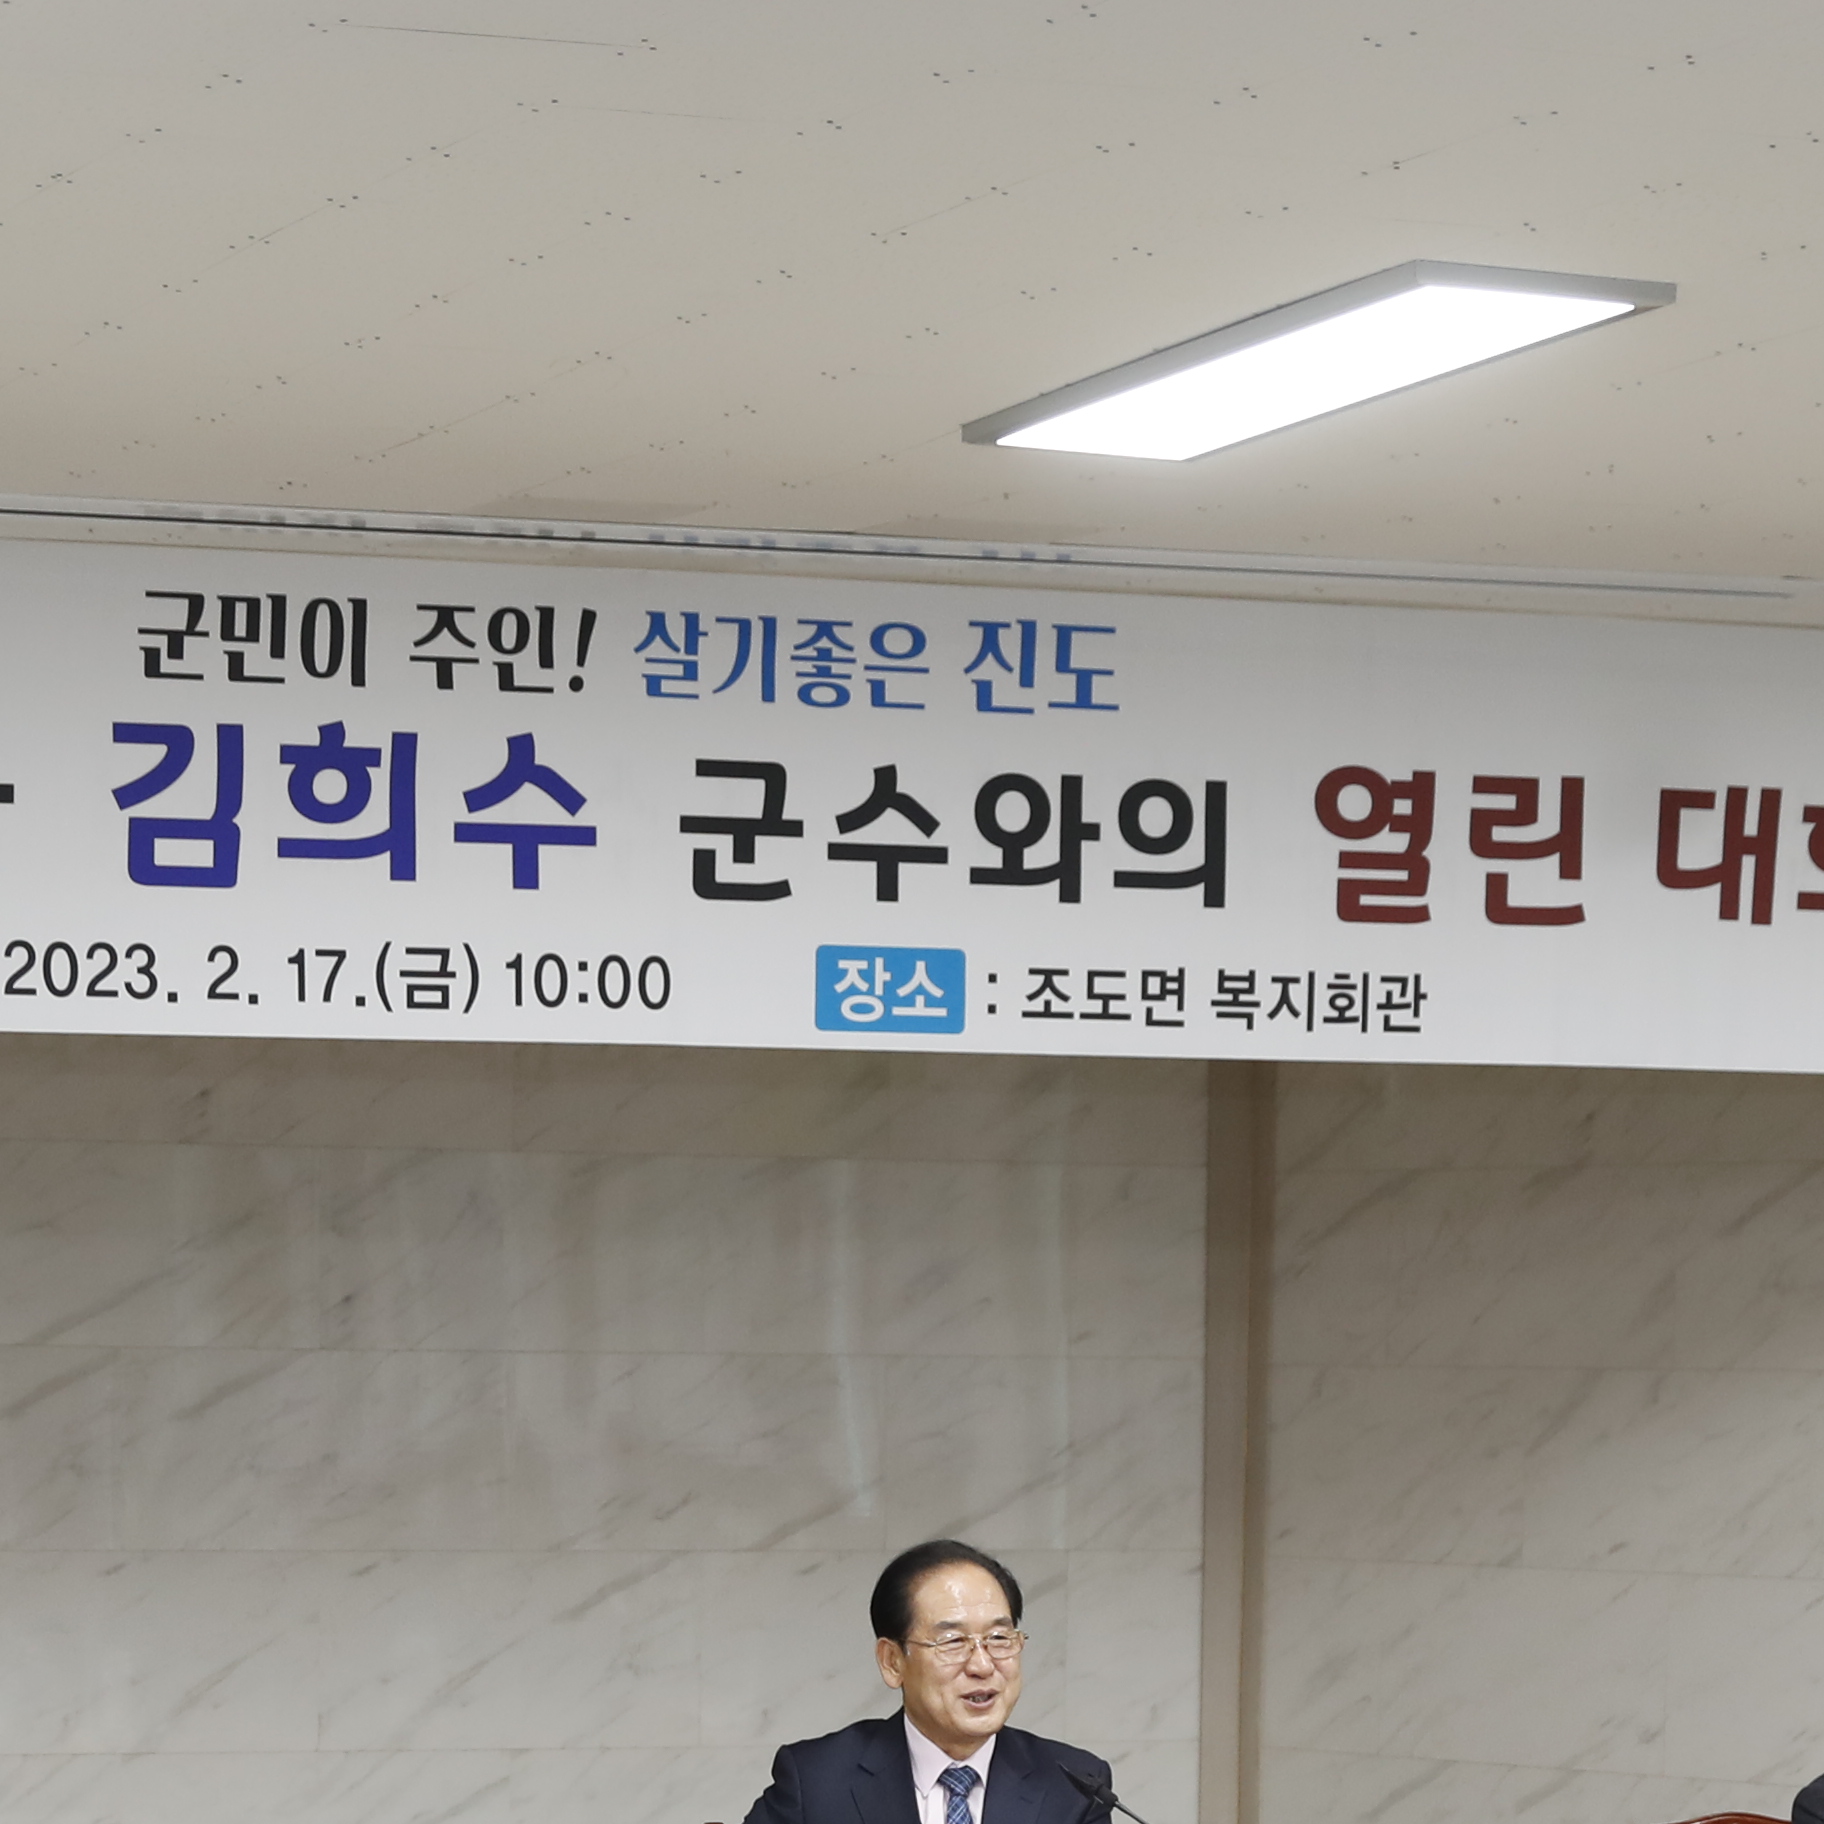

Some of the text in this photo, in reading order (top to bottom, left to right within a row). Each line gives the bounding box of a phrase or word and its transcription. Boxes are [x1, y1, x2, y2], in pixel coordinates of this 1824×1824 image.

[136, 589, 1120, 715] 군민이 주인! 살기좋은 진도
[109, 719, 599, 892] 김희수
[678, 757, 1229, 909] 군수와의
[1312, 764, 1587, 928] 열린
[3, 939, 179, 1004] 2023.
[206, 944, 259, 1005] 2.
[286, 940, 480, 1014] 17.(금)
[505, 952, 671, 1011] 10:00
[834, 958, 948, 1022] 장소
[1021, 966, 1187, 1028] 조도면
[1210, 968, 1428, 1034] 복지회관
